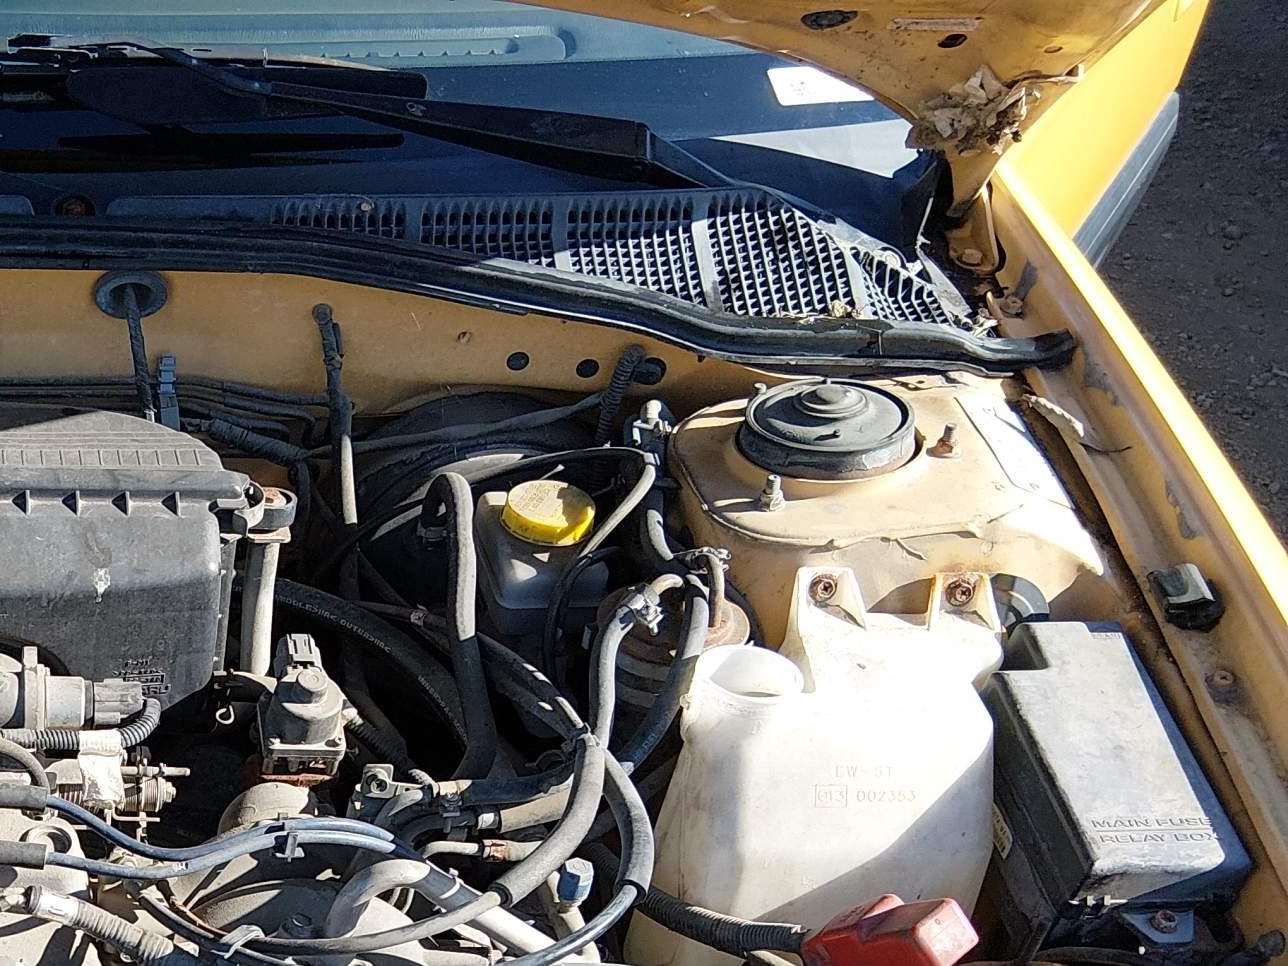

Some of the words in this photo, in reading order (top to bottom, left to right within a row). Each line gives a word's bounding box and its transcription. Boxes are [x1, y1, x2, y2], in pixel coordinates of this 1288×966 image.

[1091, 818, 1151, 828] MAIN
[1154, 816, 1215, 828] FUSE
[1097, 832, 1166, 844] RELAY
